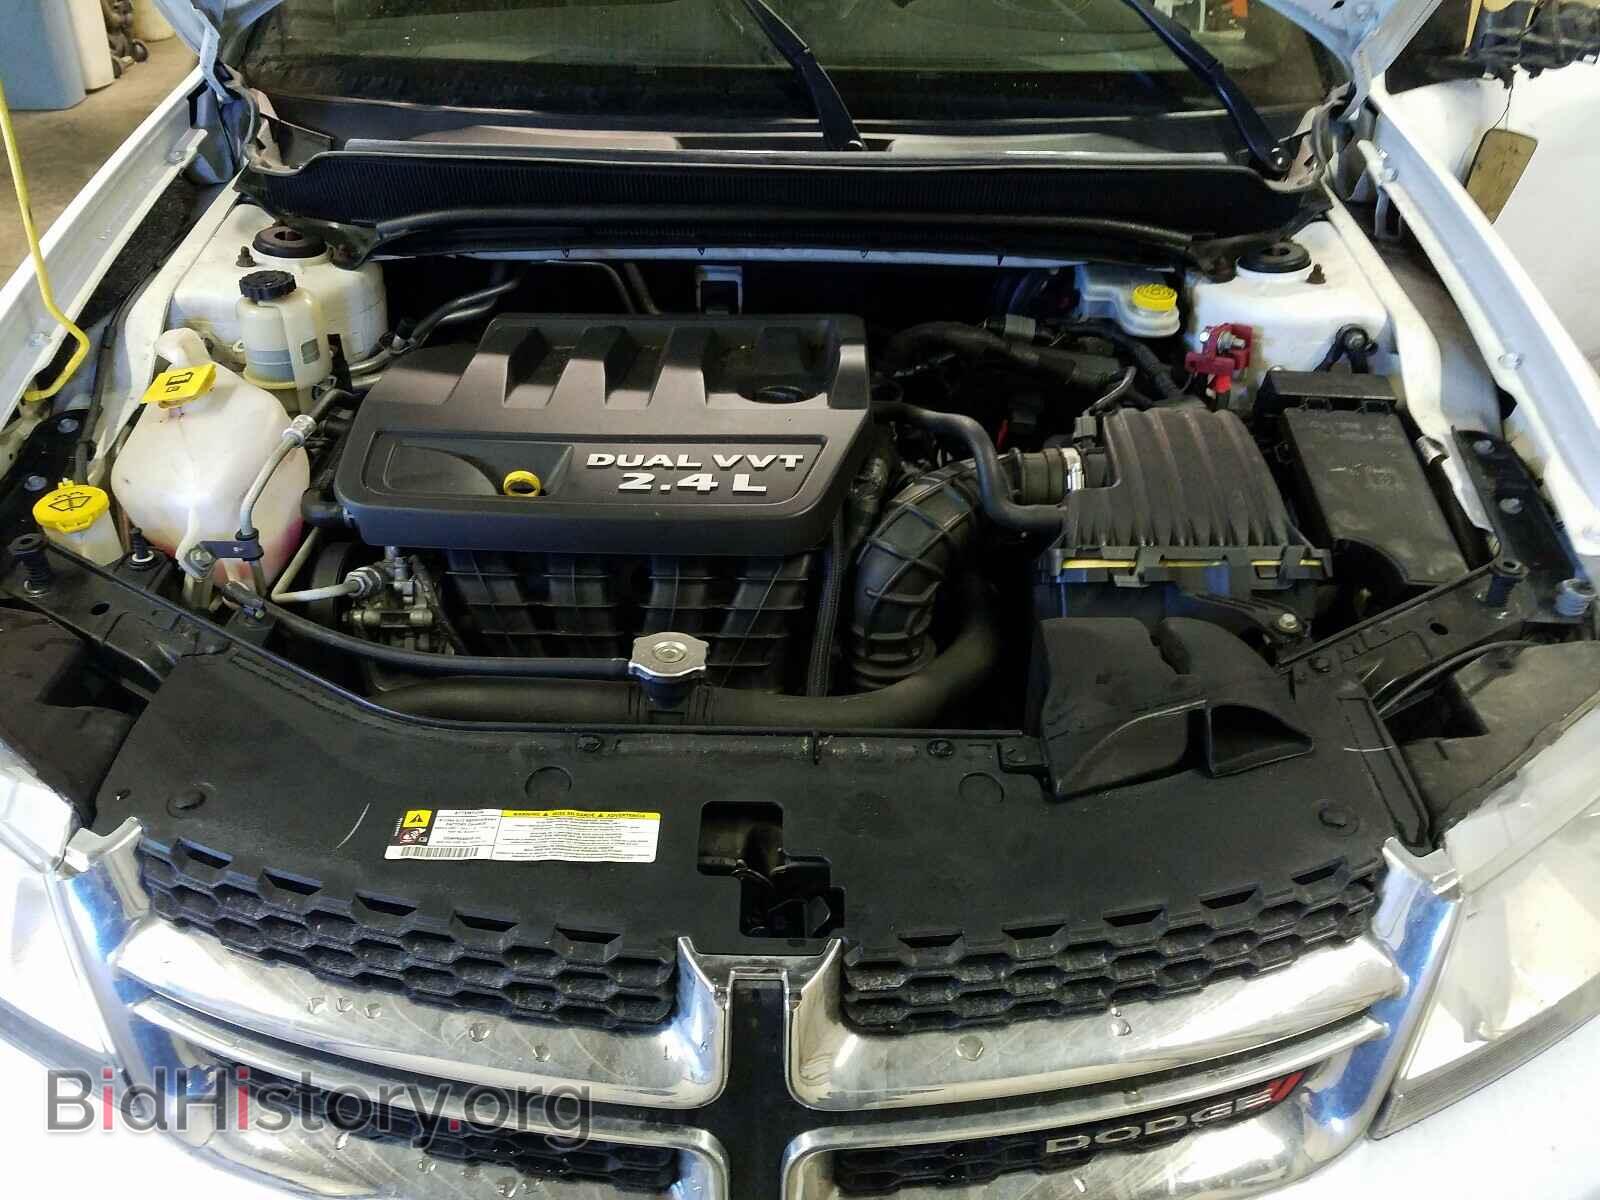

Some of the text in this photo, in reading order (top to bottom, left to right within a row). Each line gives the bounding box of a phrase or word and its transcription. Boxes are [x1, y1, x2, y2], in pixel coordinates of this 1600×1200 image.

[586, 453, 804, 471] DUAL VVT
[1046, 1088, 1273, 1153] DODGE
